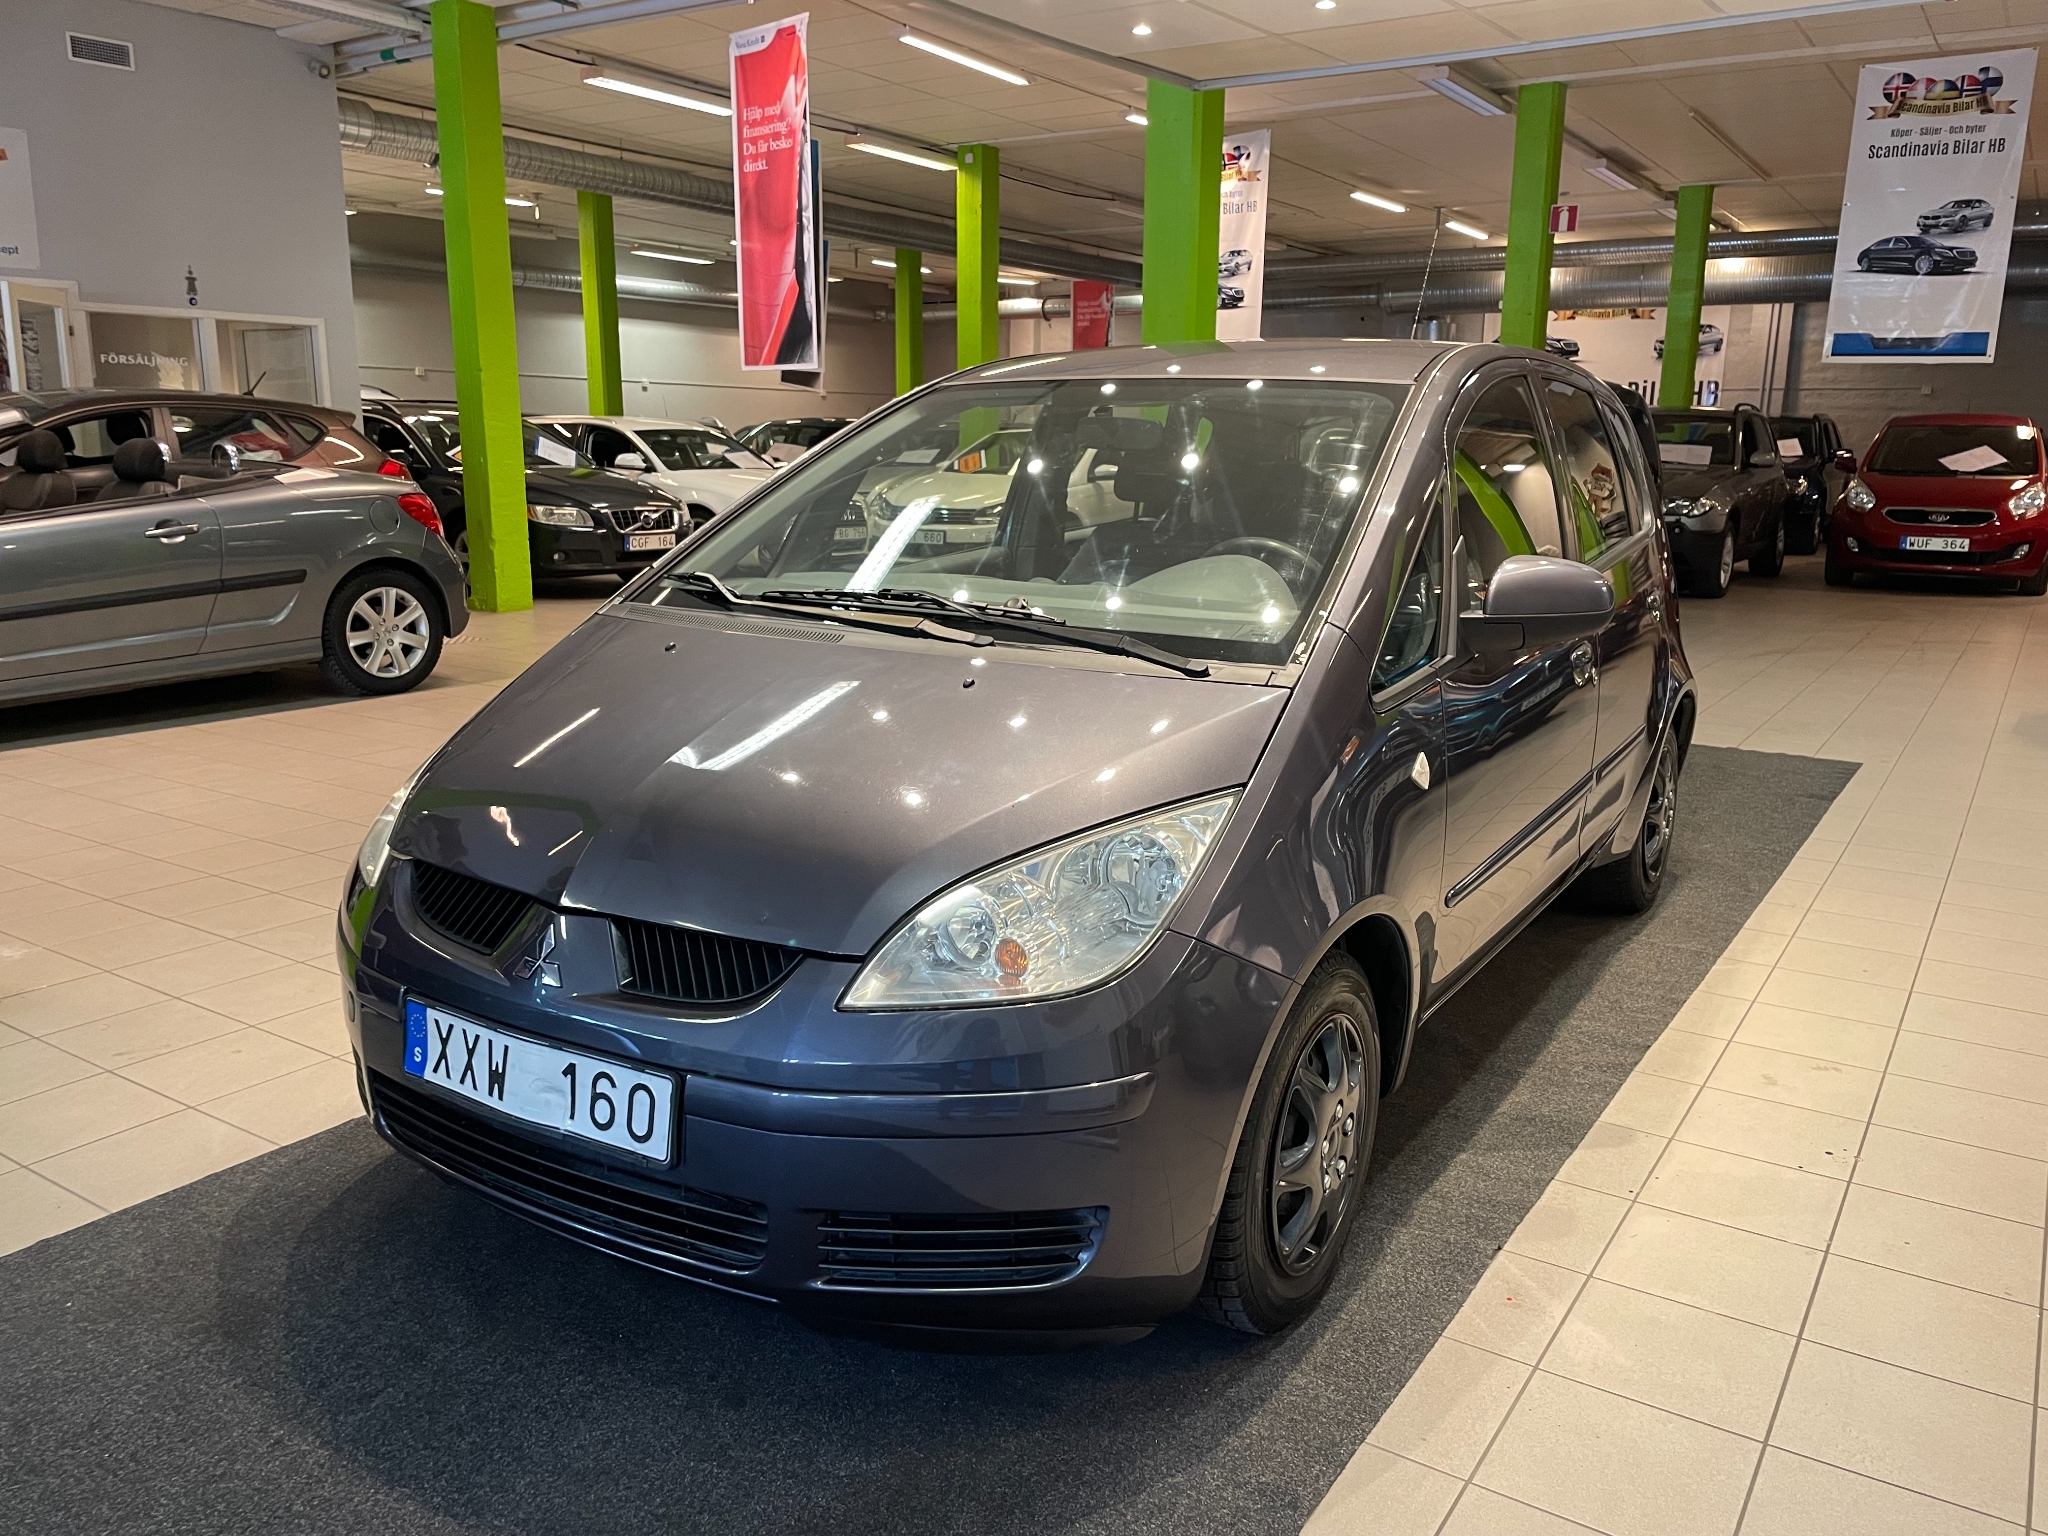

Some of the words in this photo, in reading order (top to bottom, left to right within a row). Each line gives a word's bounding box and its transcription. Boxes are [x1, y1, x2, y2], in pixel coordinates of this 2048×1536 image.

[743, 106, 763, 123] Hjälp
[764, 101, 781, 117] med
[1953, 101, 1974, 113] Bilar
[1891, 128, 1913, 138] Köper
[1919, 127, 1942, 137] Säljer
[1949, 125, 1964, 135] Och
[1965, 124, 1987, 135] byter
[743, 142, 757, 156] Du
[1868, 140, 1949, 159] Scandinavia
[1952, 139, 1986, 154] Bilar
[1988, 138, 2006, 153] HB
[1222, 202, 1244, 215] Bilar
[1246, 201, 1258, 213] HB
[0, 245, 19, 256] ept
[631, 537, 650, 548] CGF
[658, 536, 674, 547] 164
[924, 532, 942, 543] 660
[1908, 538, 1932, 548] WUF
[1942, 539, 1966, 549] 364
[414, 1047, 422, 1062] S
[432, 1018, 509, 1102] XXW
[561, 1062, 656, 1144] 160
